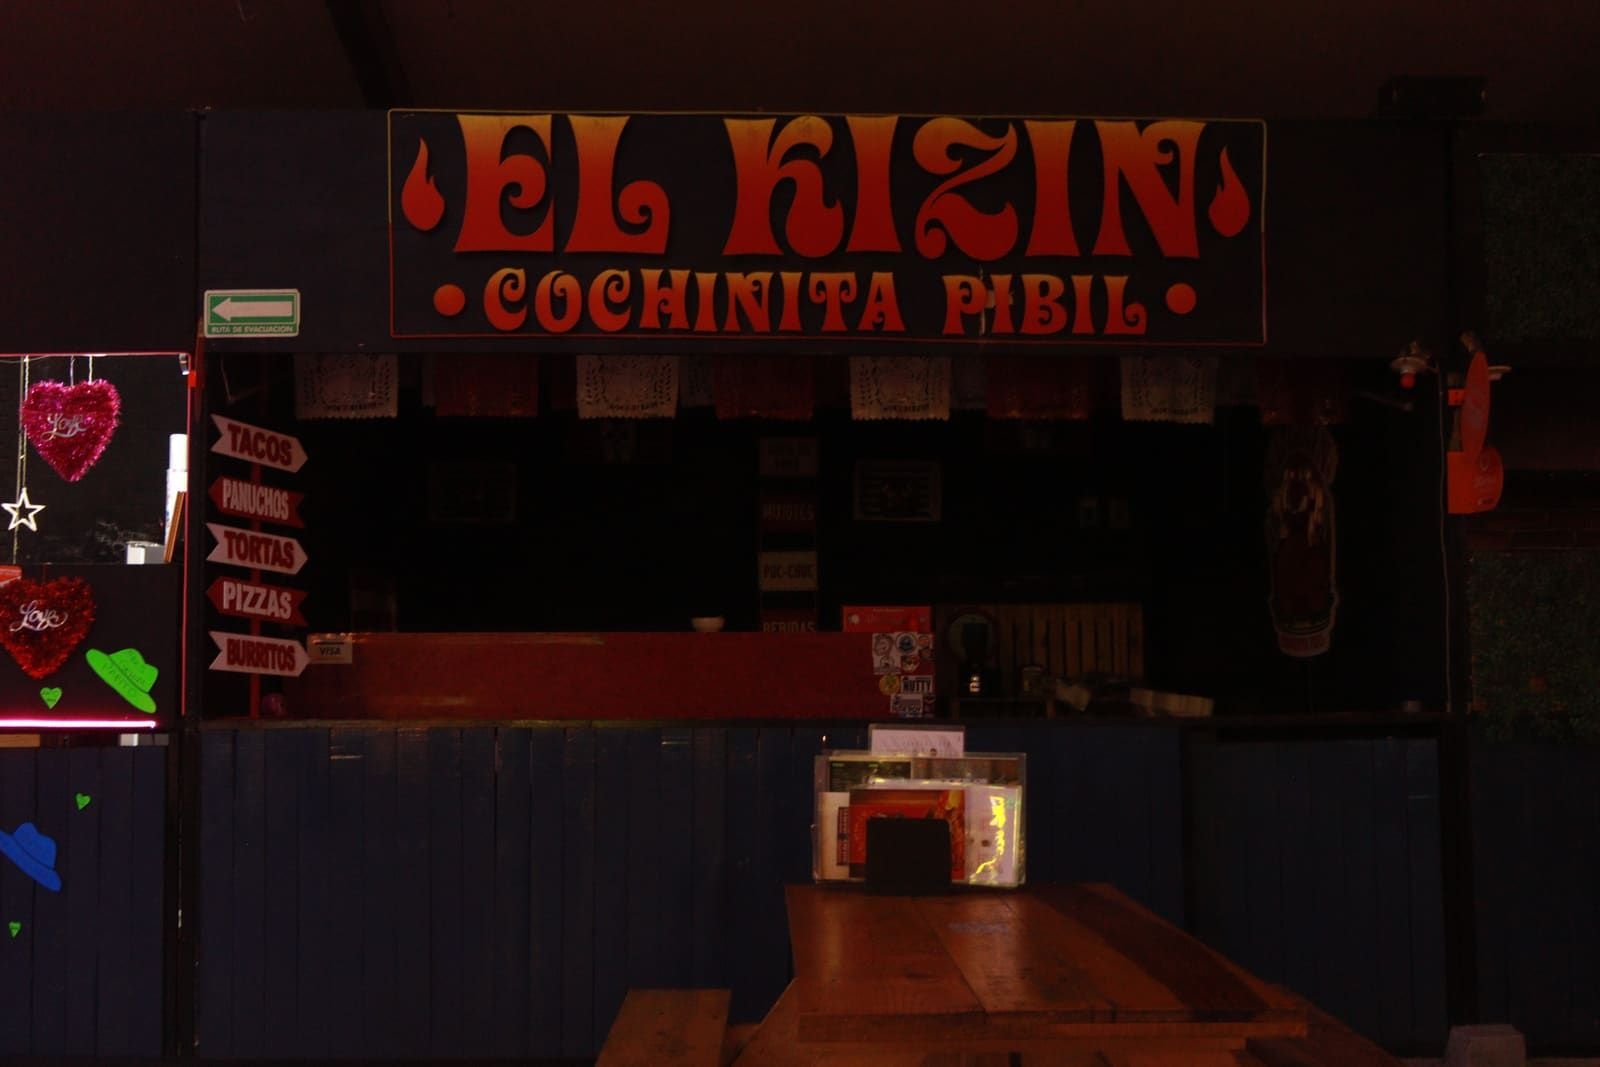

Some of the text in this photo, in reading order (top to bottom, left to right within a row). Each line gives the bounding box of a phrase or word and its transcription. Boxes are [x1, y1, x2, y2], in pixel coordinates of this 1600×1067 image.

[453, 113, 1208, 262] EL KIZIN
[483, 267, 1149, 336] COCHINITA PIBIL
[228, 424, 291, 466] TACOS
[223, 477, 289, 520] PANUCHOS
[224, 531, 294, 568] TORTAS
[10, 600, 68, 632] Love
[223, 580, 292, 620] PIZZAS
[227, 639, 295, 671] BURRITOS
[319, 647, 341, 655] VISA
